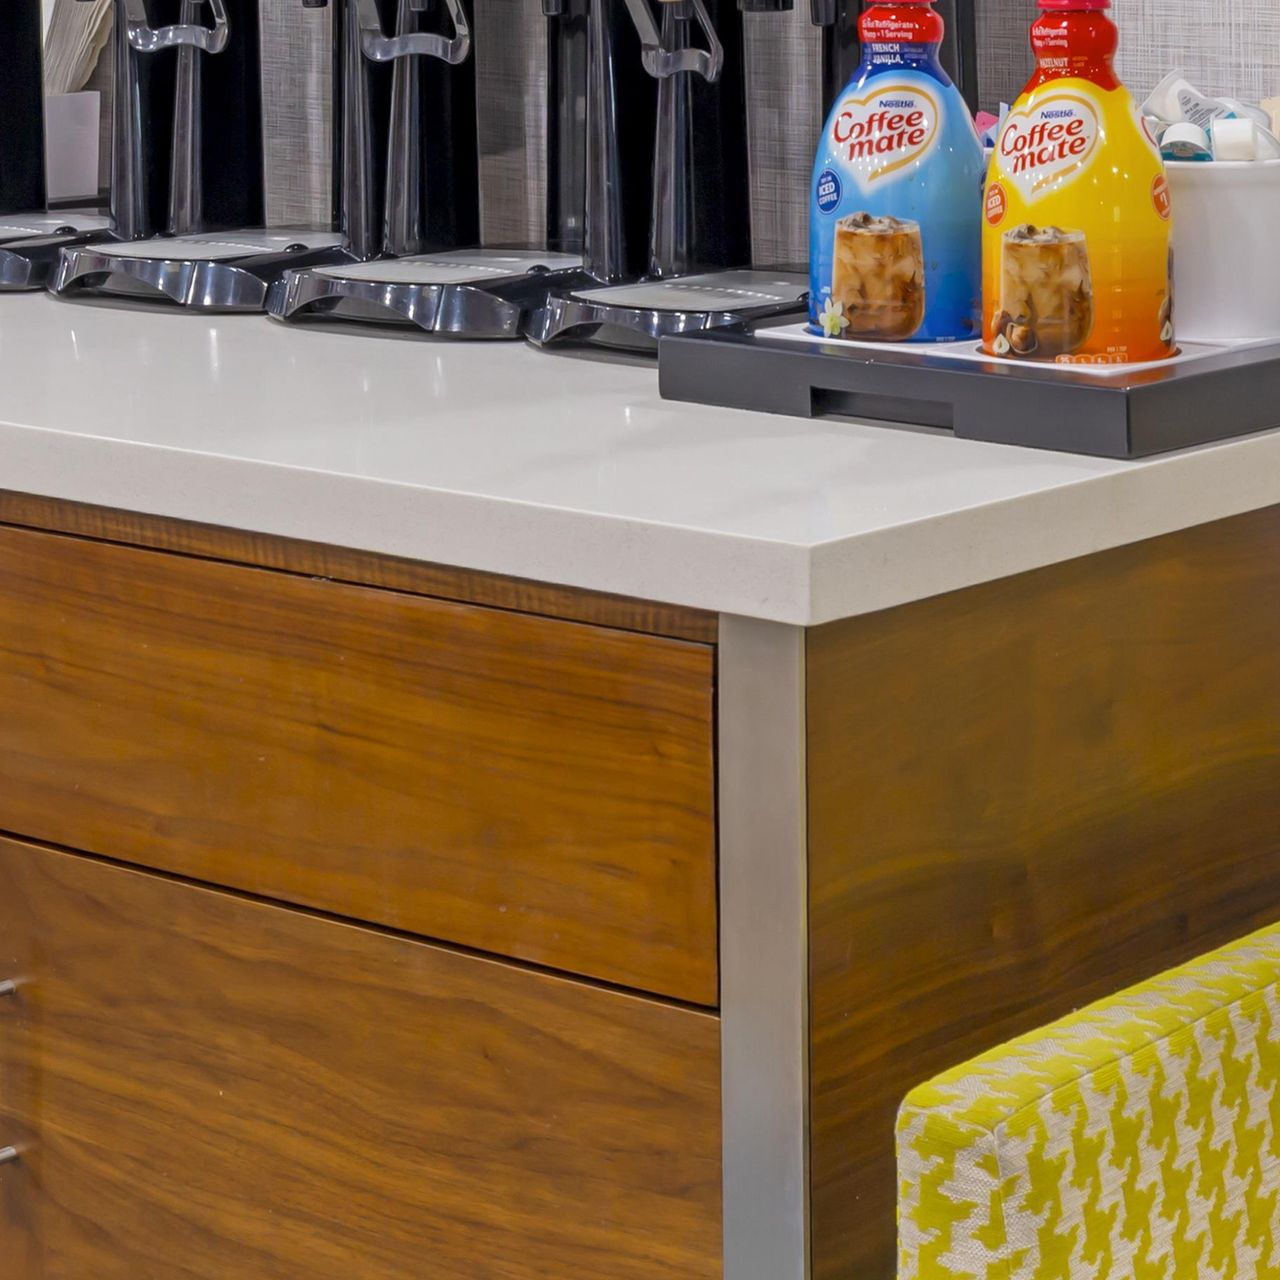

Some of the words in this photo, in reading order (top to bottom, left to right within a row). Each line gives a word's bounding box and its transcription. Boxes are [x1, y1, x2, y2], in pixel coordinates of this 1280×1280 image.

[834, 111, 924, 144] Coffee
[1001, 119, 1084, 157] Coffee
[849, 128, 925, 161] mate
[1013, 136, 1086, 174] mate
[819, 182, 836, 197] ICED
